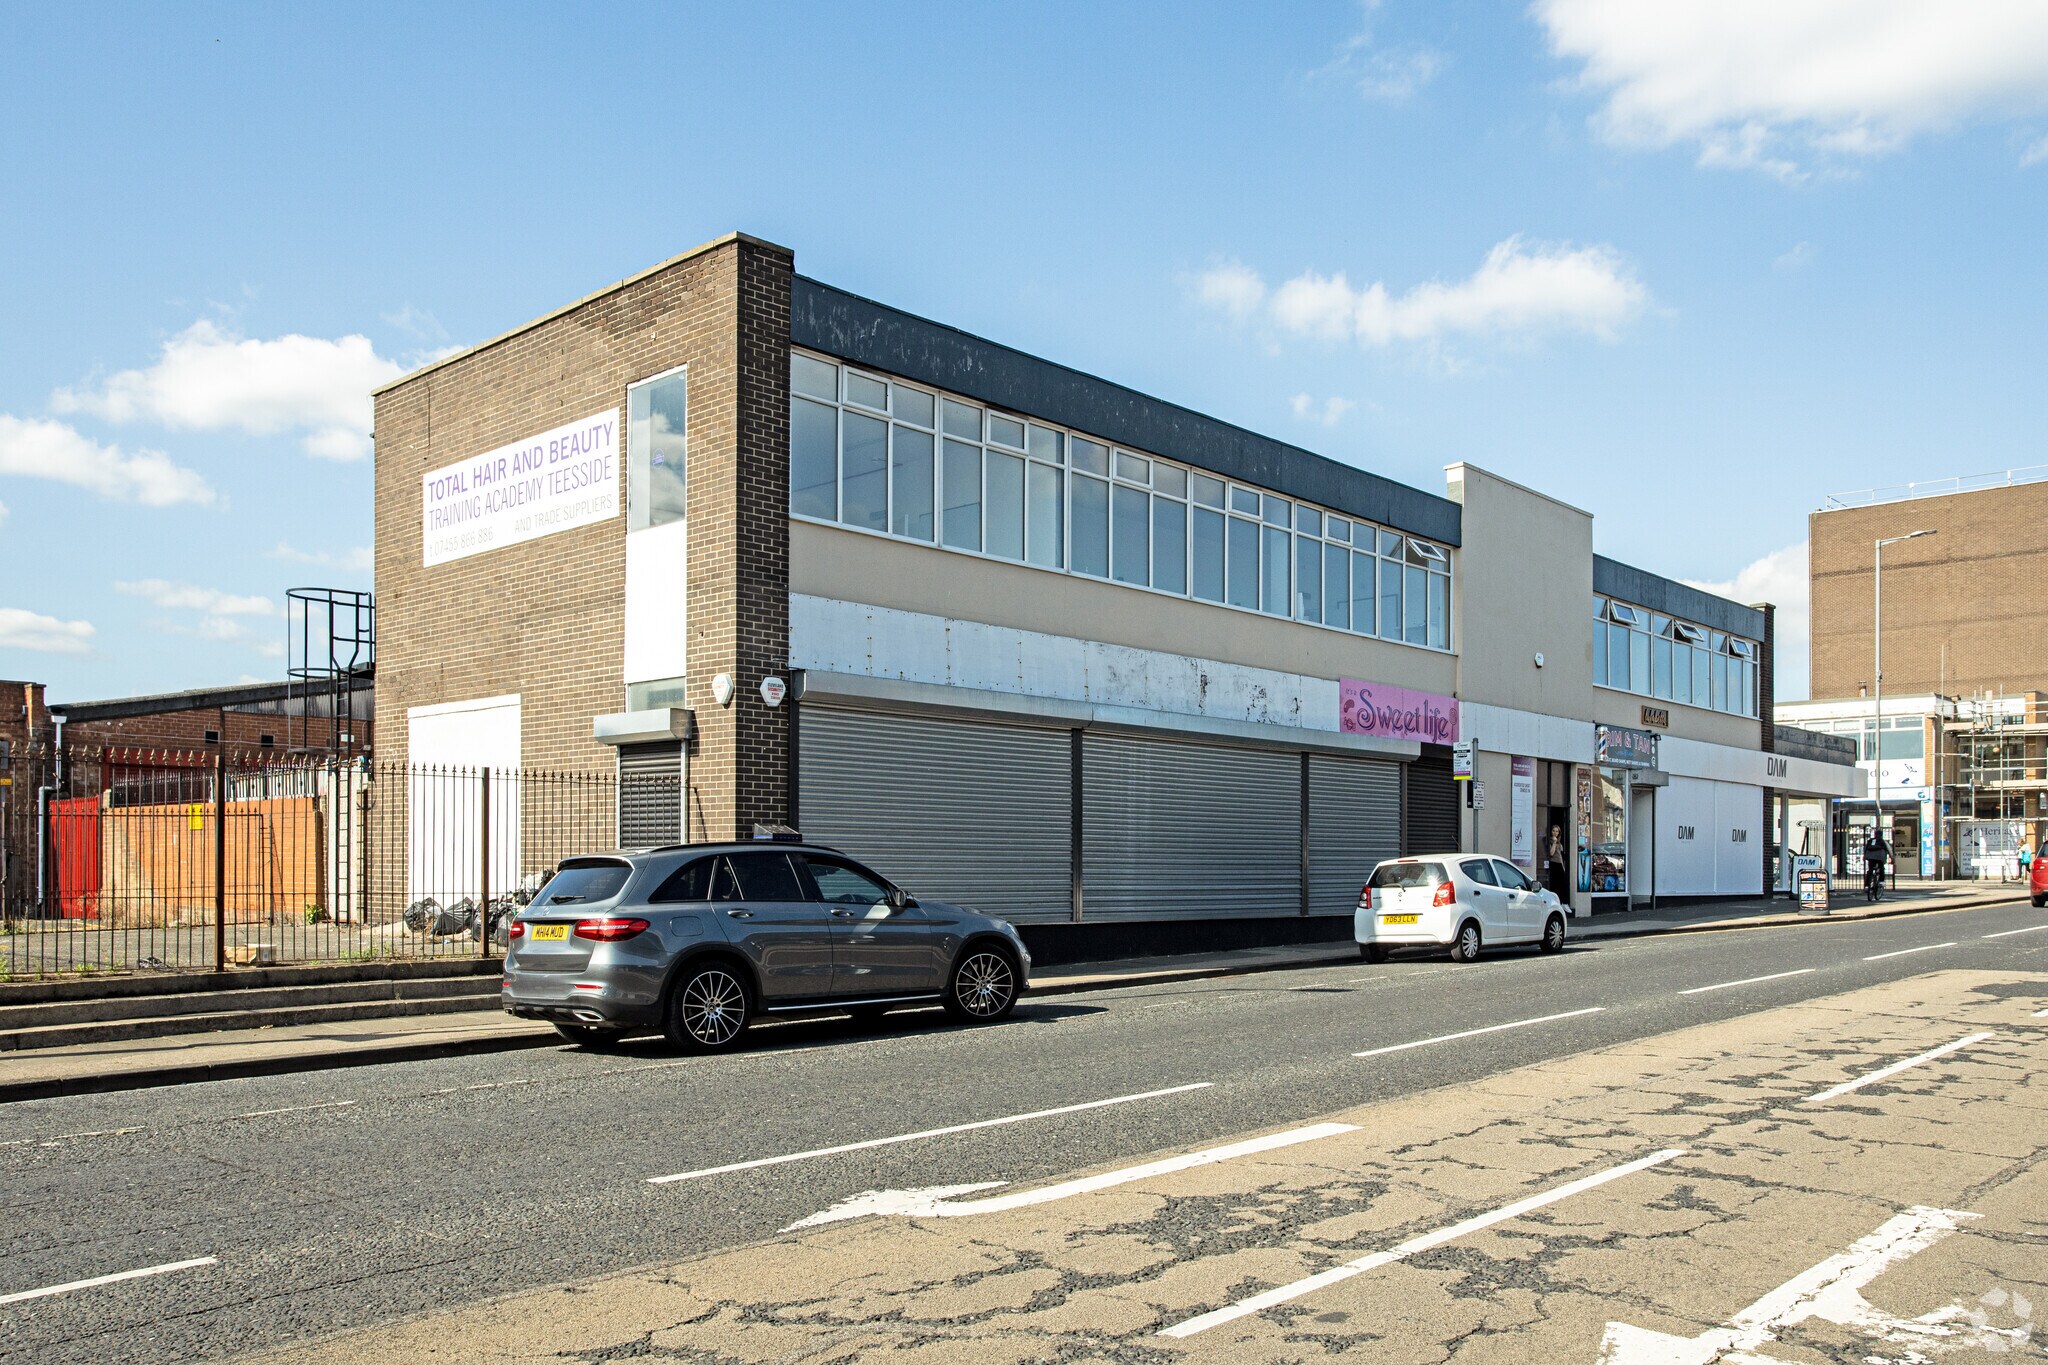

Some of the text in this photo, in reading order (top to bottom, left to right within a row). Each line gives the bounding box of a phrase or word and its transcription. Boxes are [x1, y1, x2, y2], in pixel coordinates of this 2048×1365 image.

[428, 421, 613, 503] TOTAL HAIR AND BEAUTY
[429, 455, 612, 531] TRAINING ACADEMY TEESSIDE
[514, 493, 613, 534] AND TRADE SUPPLIERS
[1357, 688, 1449, 744] Sweet life
[1633, 733, 1650, 755] TAN
[1767, 757, 1787, 778] DAM
[1678, 825, 1695, 840] DAM
[1732, 829, 1747, 843] DAM
